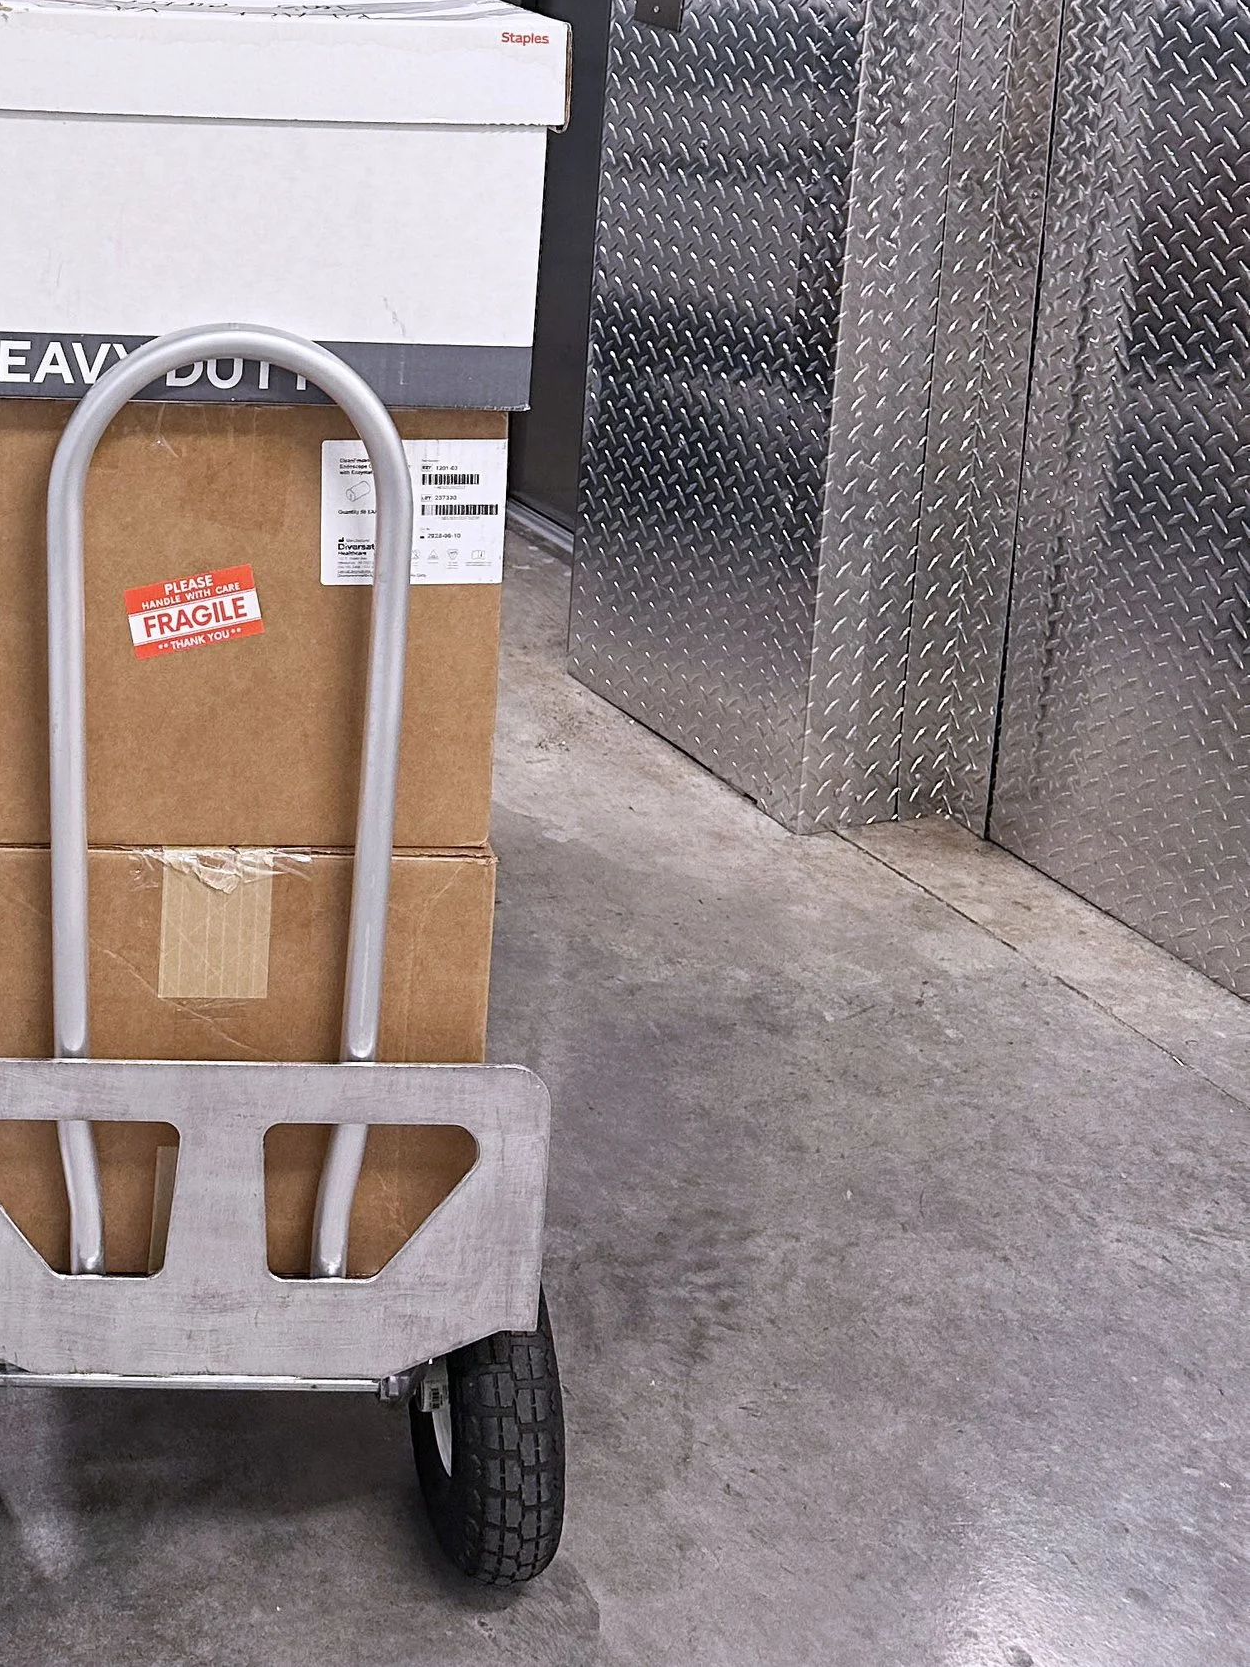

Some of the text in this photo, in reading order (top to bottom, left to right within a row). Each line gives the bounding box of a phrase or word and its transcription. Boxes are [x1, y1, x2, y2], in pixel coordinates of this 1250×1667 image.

[501, 32, 549, 47] Staples
[164, 574, 214, 596] PLEASE
[141, 582, 240, 611] HANDLE WITH CARE
[143, 596, 248, 638] FRAGILE
[170, 628, 231, 650] THANK YOU
